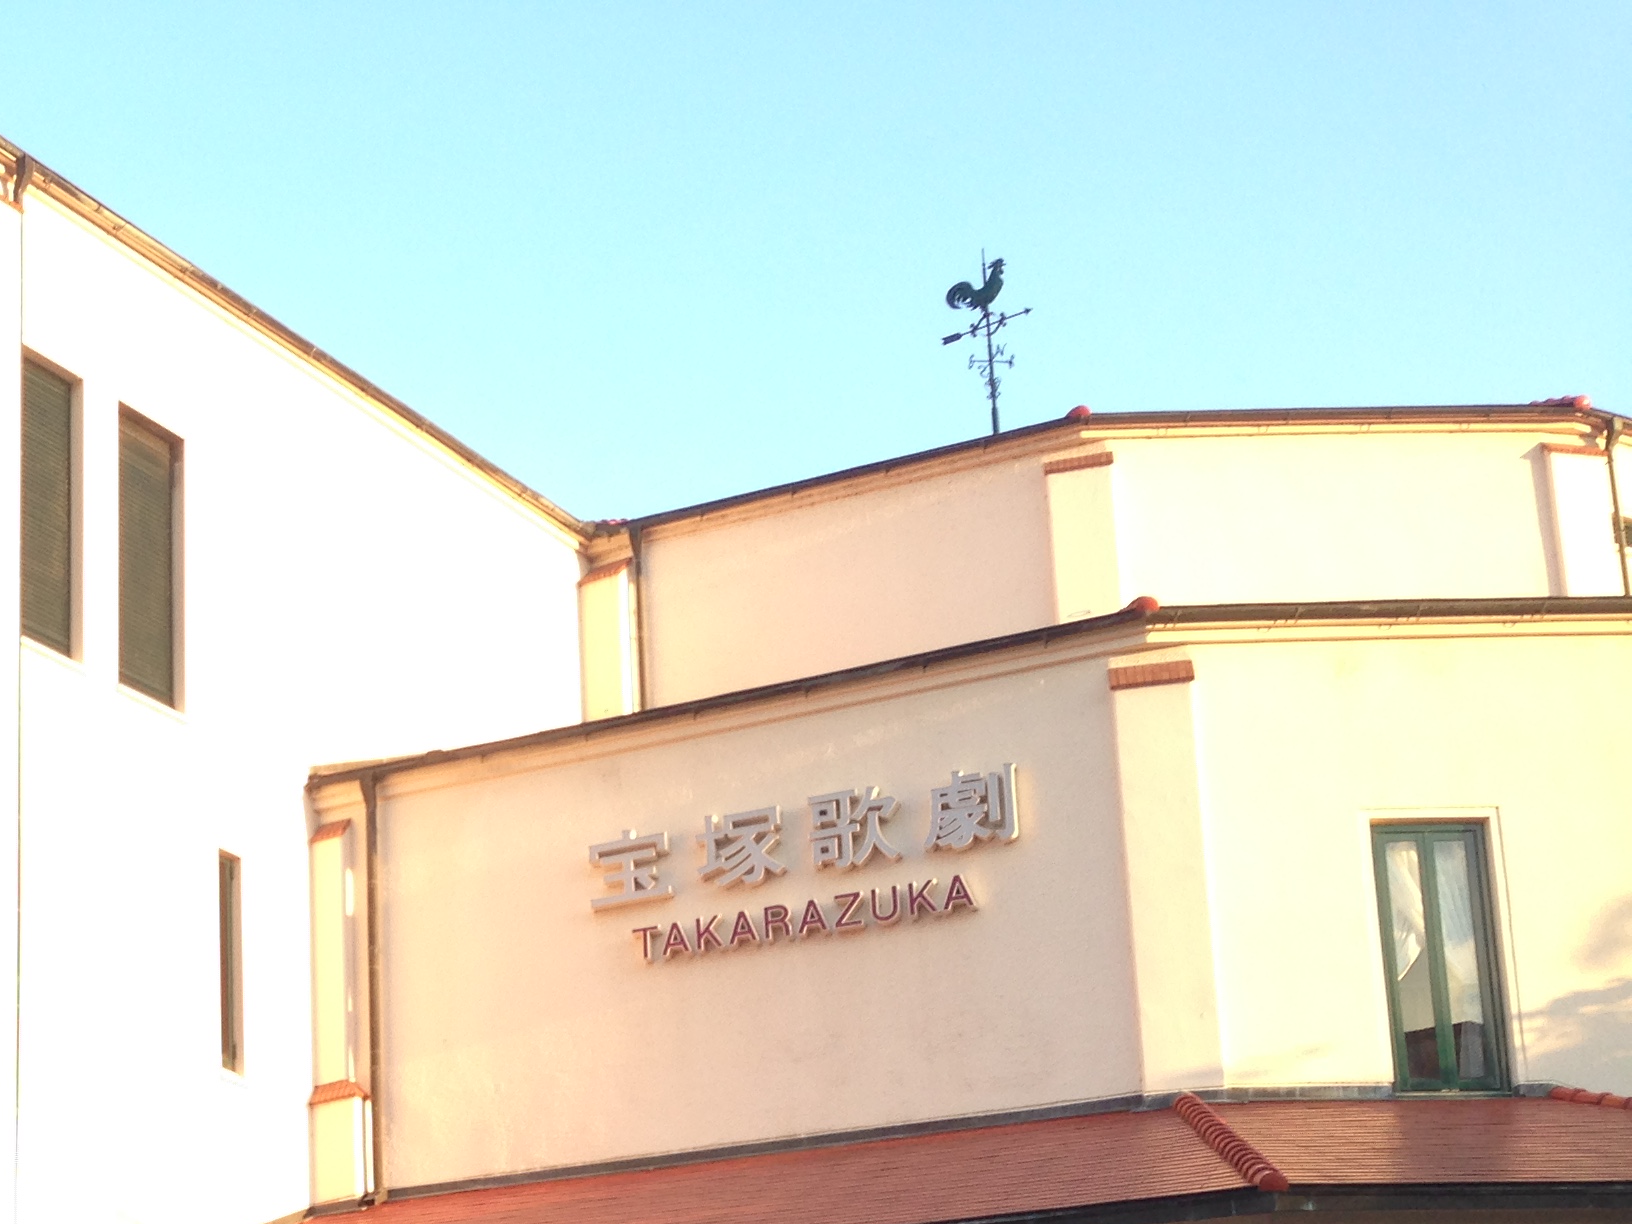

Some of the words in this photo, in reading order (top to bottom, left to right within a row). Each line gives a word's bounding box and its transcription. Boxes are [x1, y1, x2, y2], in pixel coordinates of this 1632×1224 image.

[589, 763, 1019, 912] 宝塚歌劇
[632, 874, 976, 960] TAKARAZUKA
